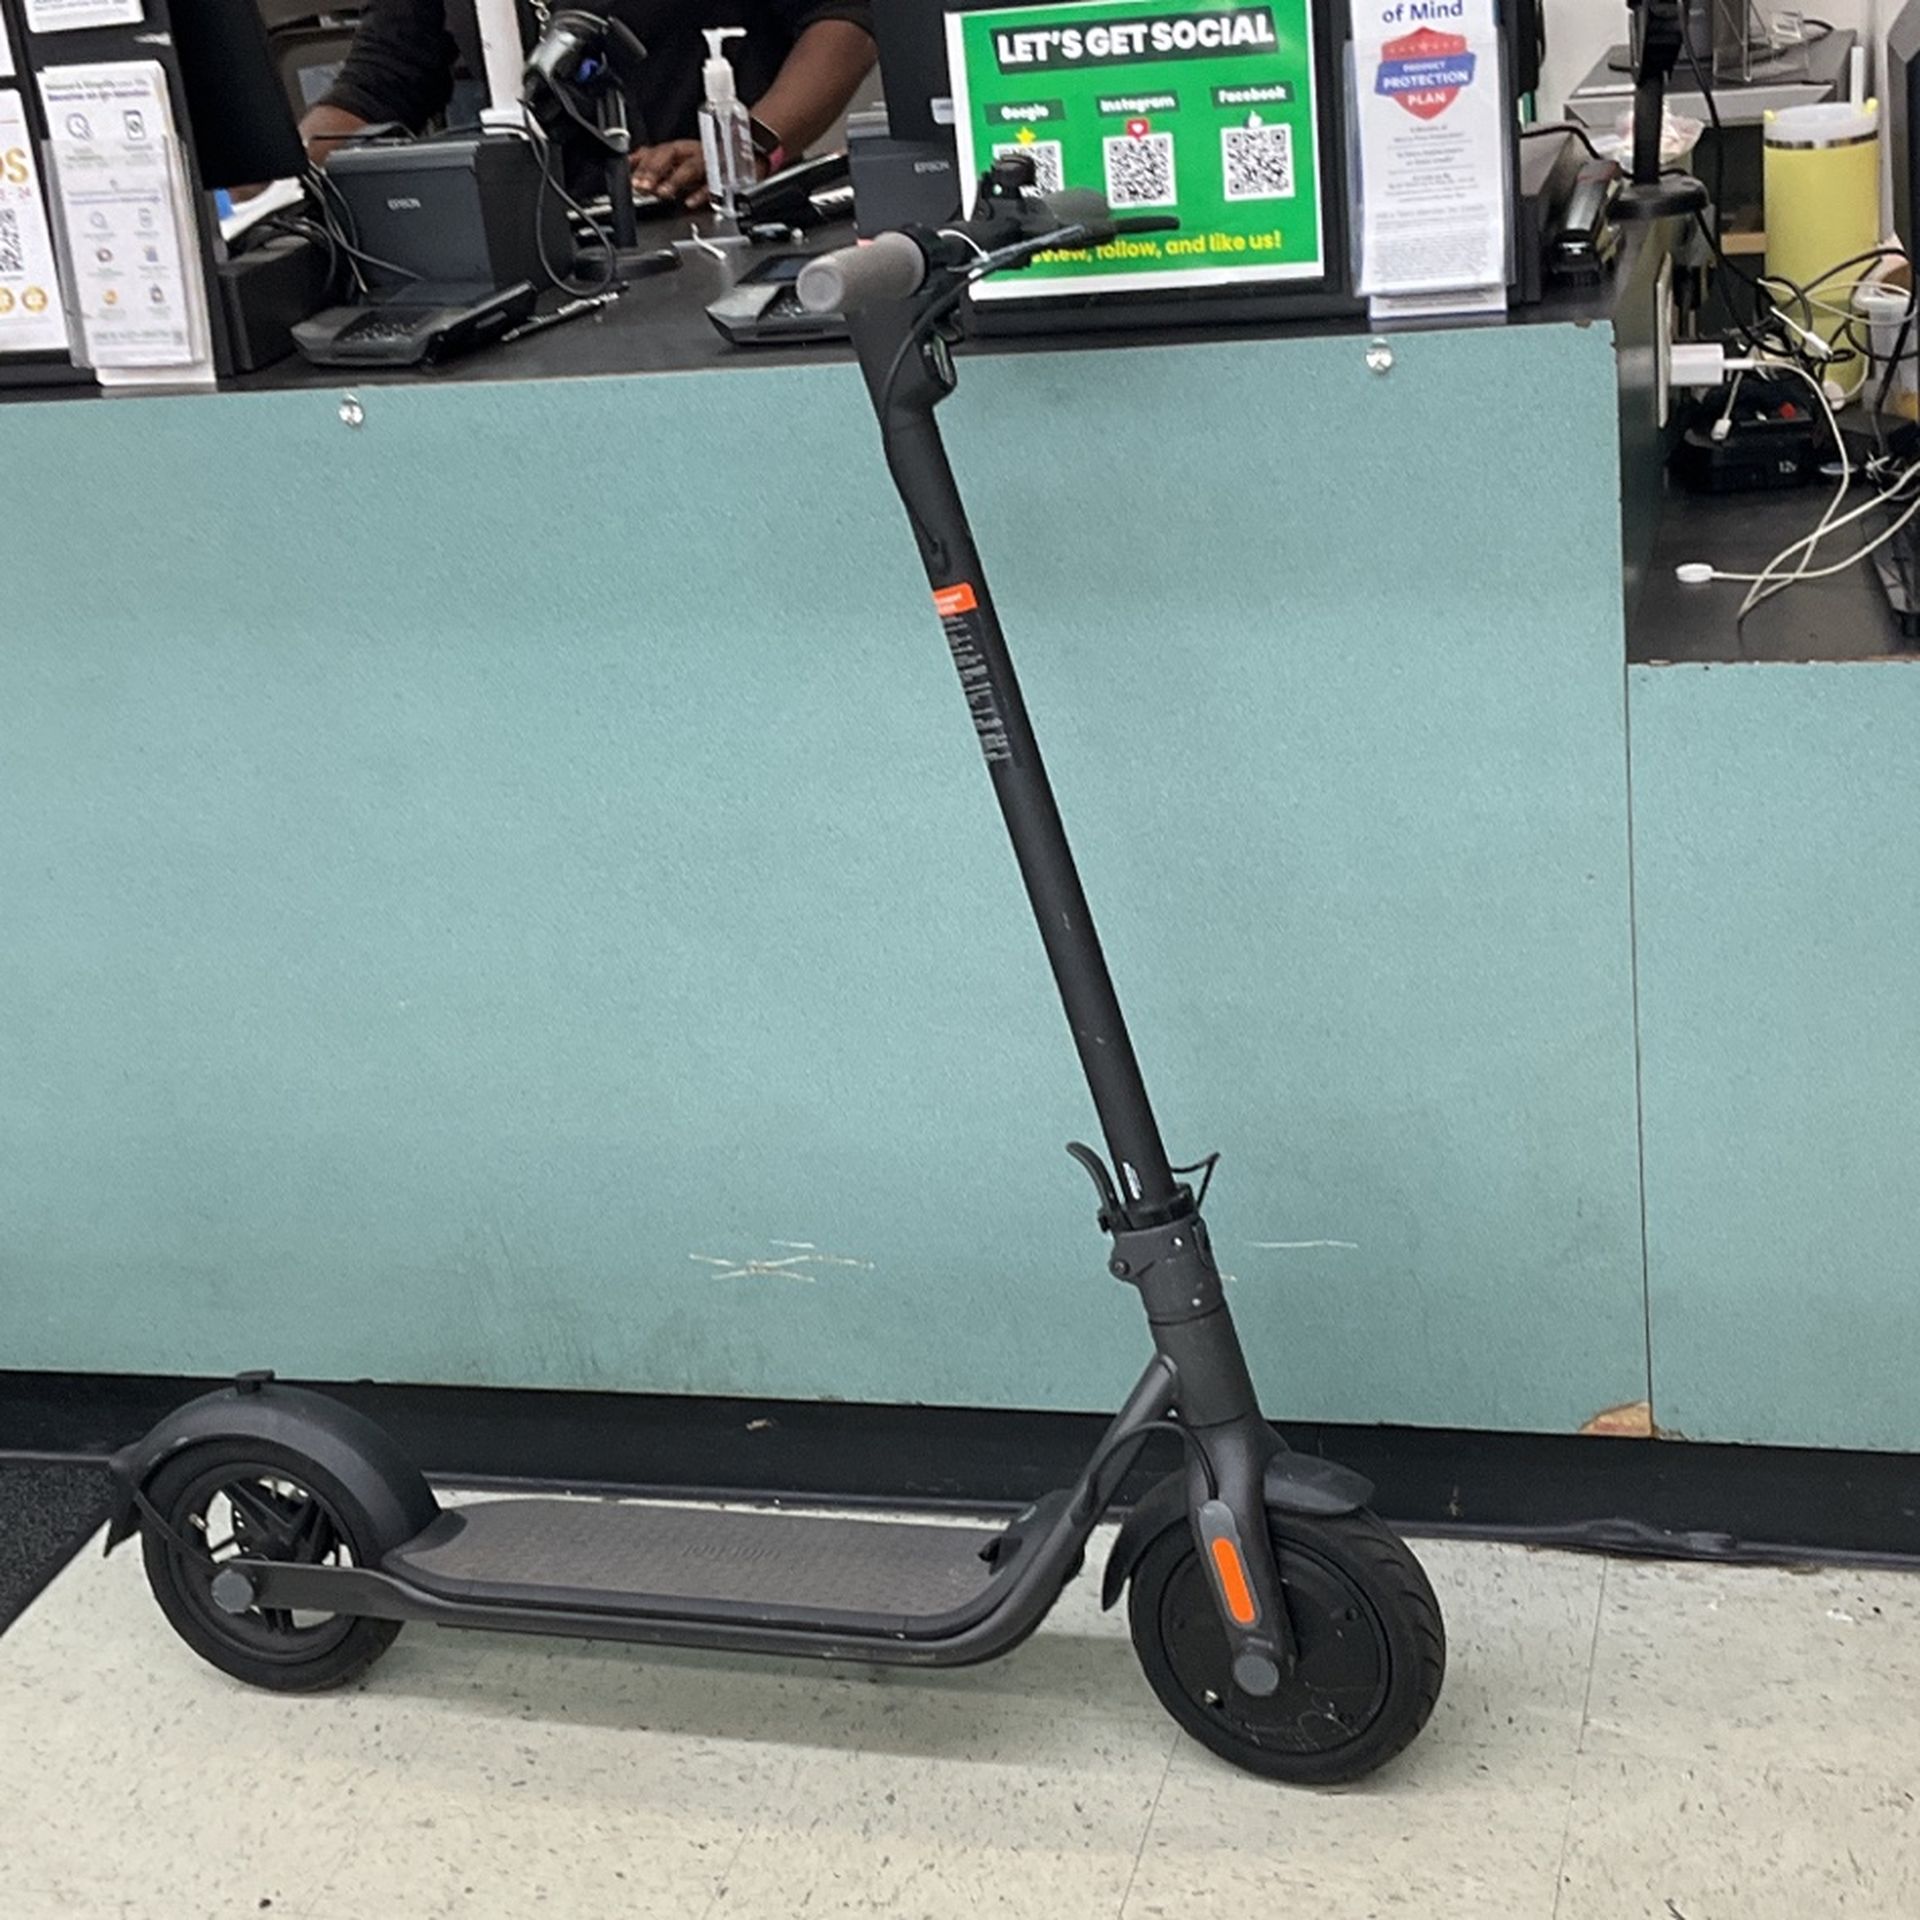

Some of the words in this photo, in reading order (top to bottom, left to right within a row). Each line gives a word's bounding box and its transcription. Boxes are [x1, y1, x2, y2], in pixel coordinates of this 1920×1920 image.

[1382, 3, 1404, 24] of
[1410, 0, 1463, 20] Mind
[996, 29, 1083, 64] LET'S
[1085, 24, 1149, 57] GET
[1151, 13, 1275, 51] SOCIAL
[1383, 71, 1469, 89] PROTECTION
[1219, 85, 1286, 103] Facebook
[1407, 92, 1446, 107] PLAN
[1001, 103, 1049, 122] Google
[1100, 96, 1176, 113] Instagram
[1165, 234, 1206, 255] and
[1208, 232, 1246, 252] like
[1248, 229, 1282, 250] us!
